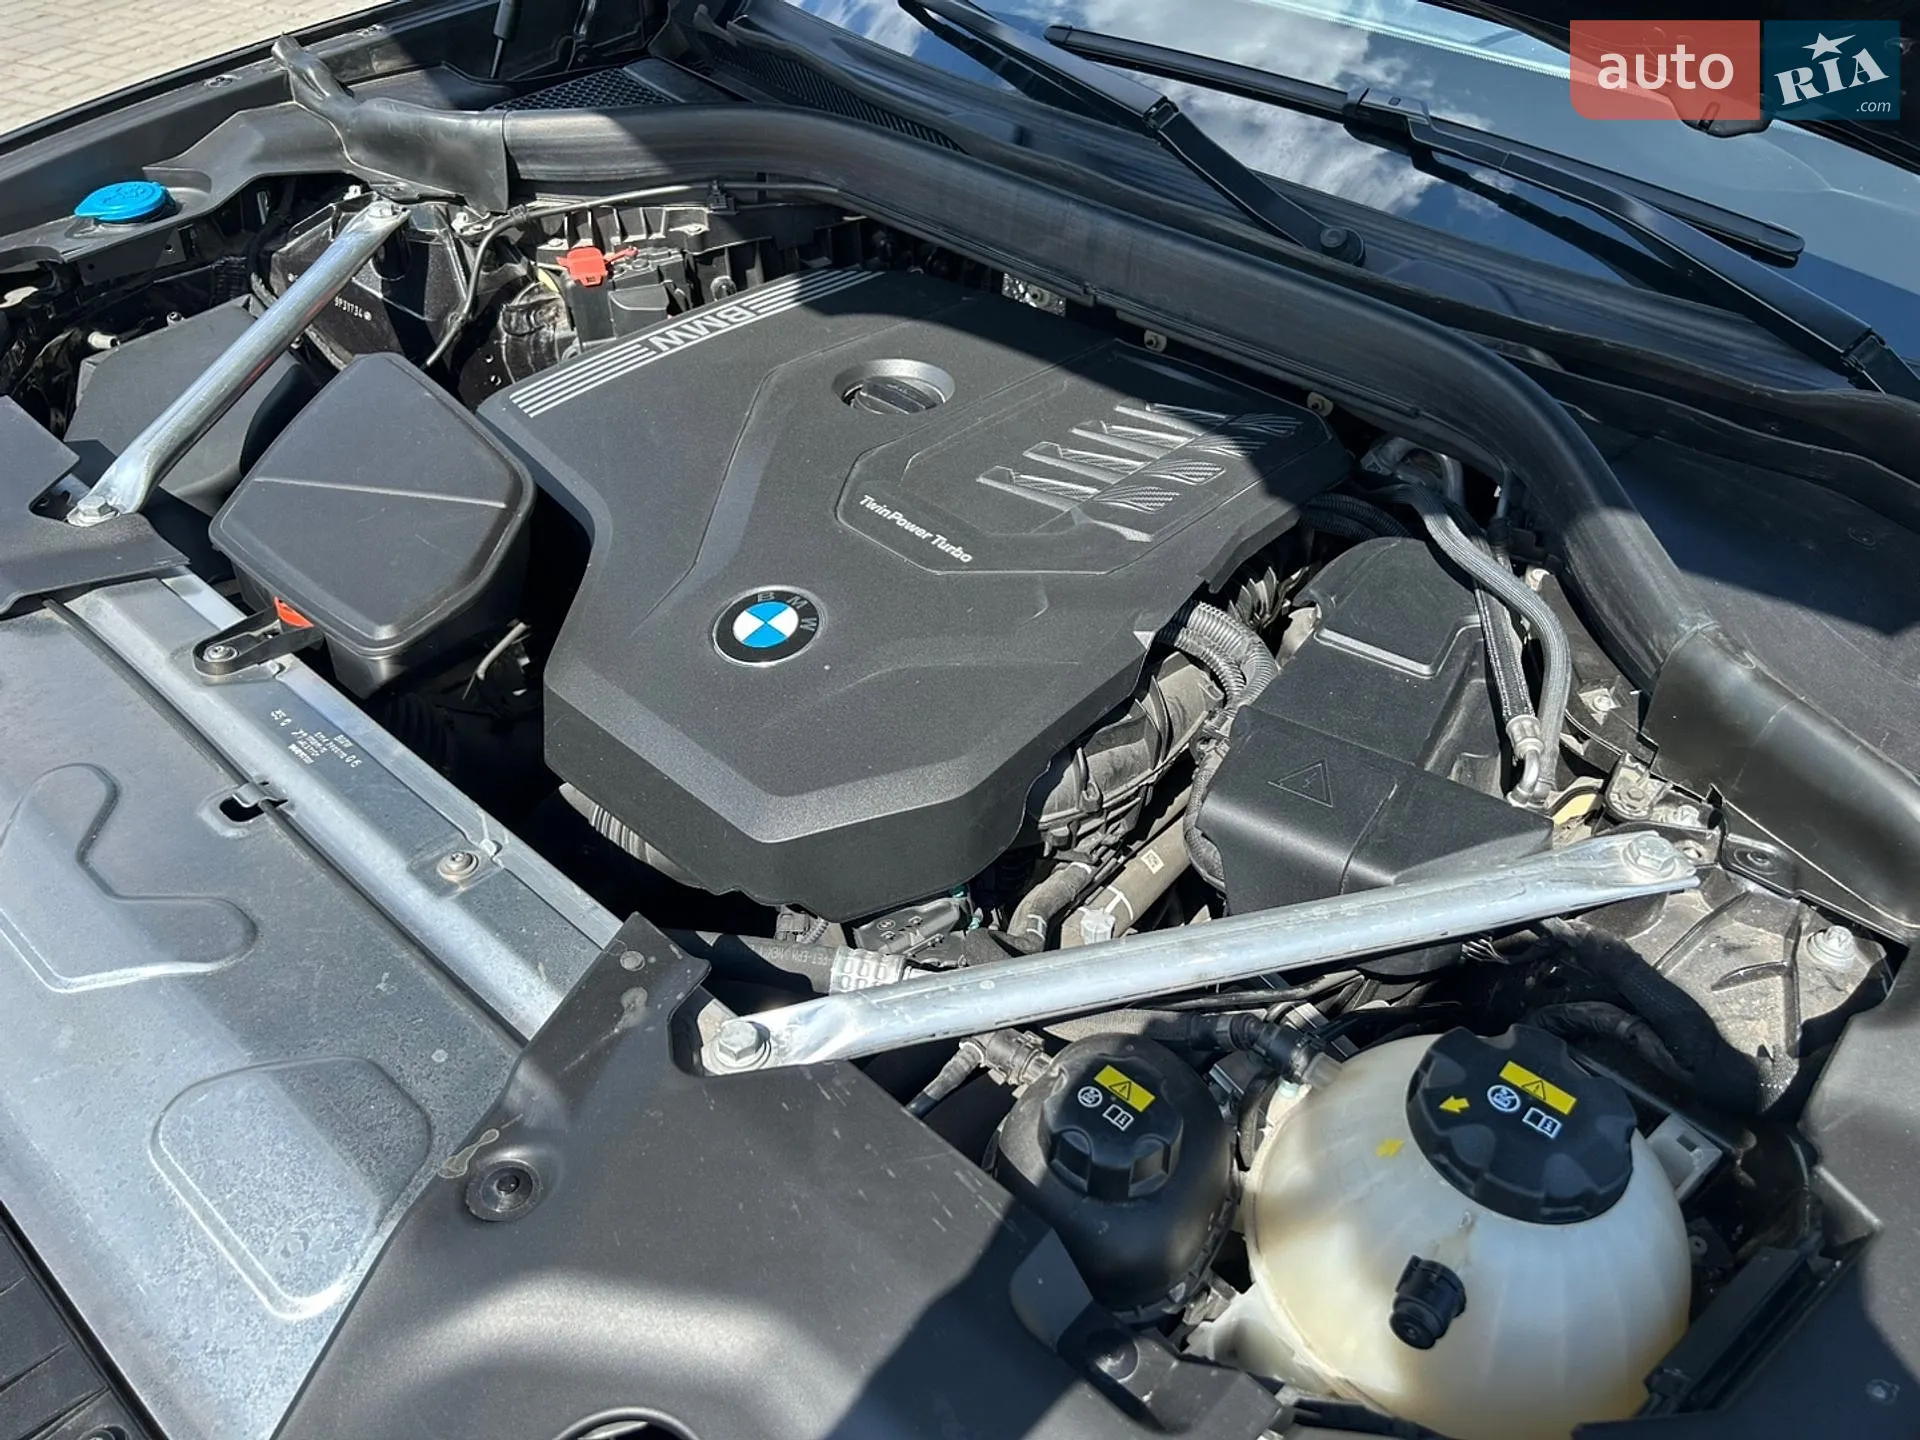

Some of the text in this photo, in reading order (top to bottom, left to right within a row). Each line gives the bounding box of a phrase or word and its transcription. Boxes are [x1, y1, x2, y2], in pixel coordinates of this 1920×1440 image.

[648, 305, 757, 351] BMW
[859, 494, 973, 563] TwinPower Turbo
[757, 591, 818, 632] BMW
